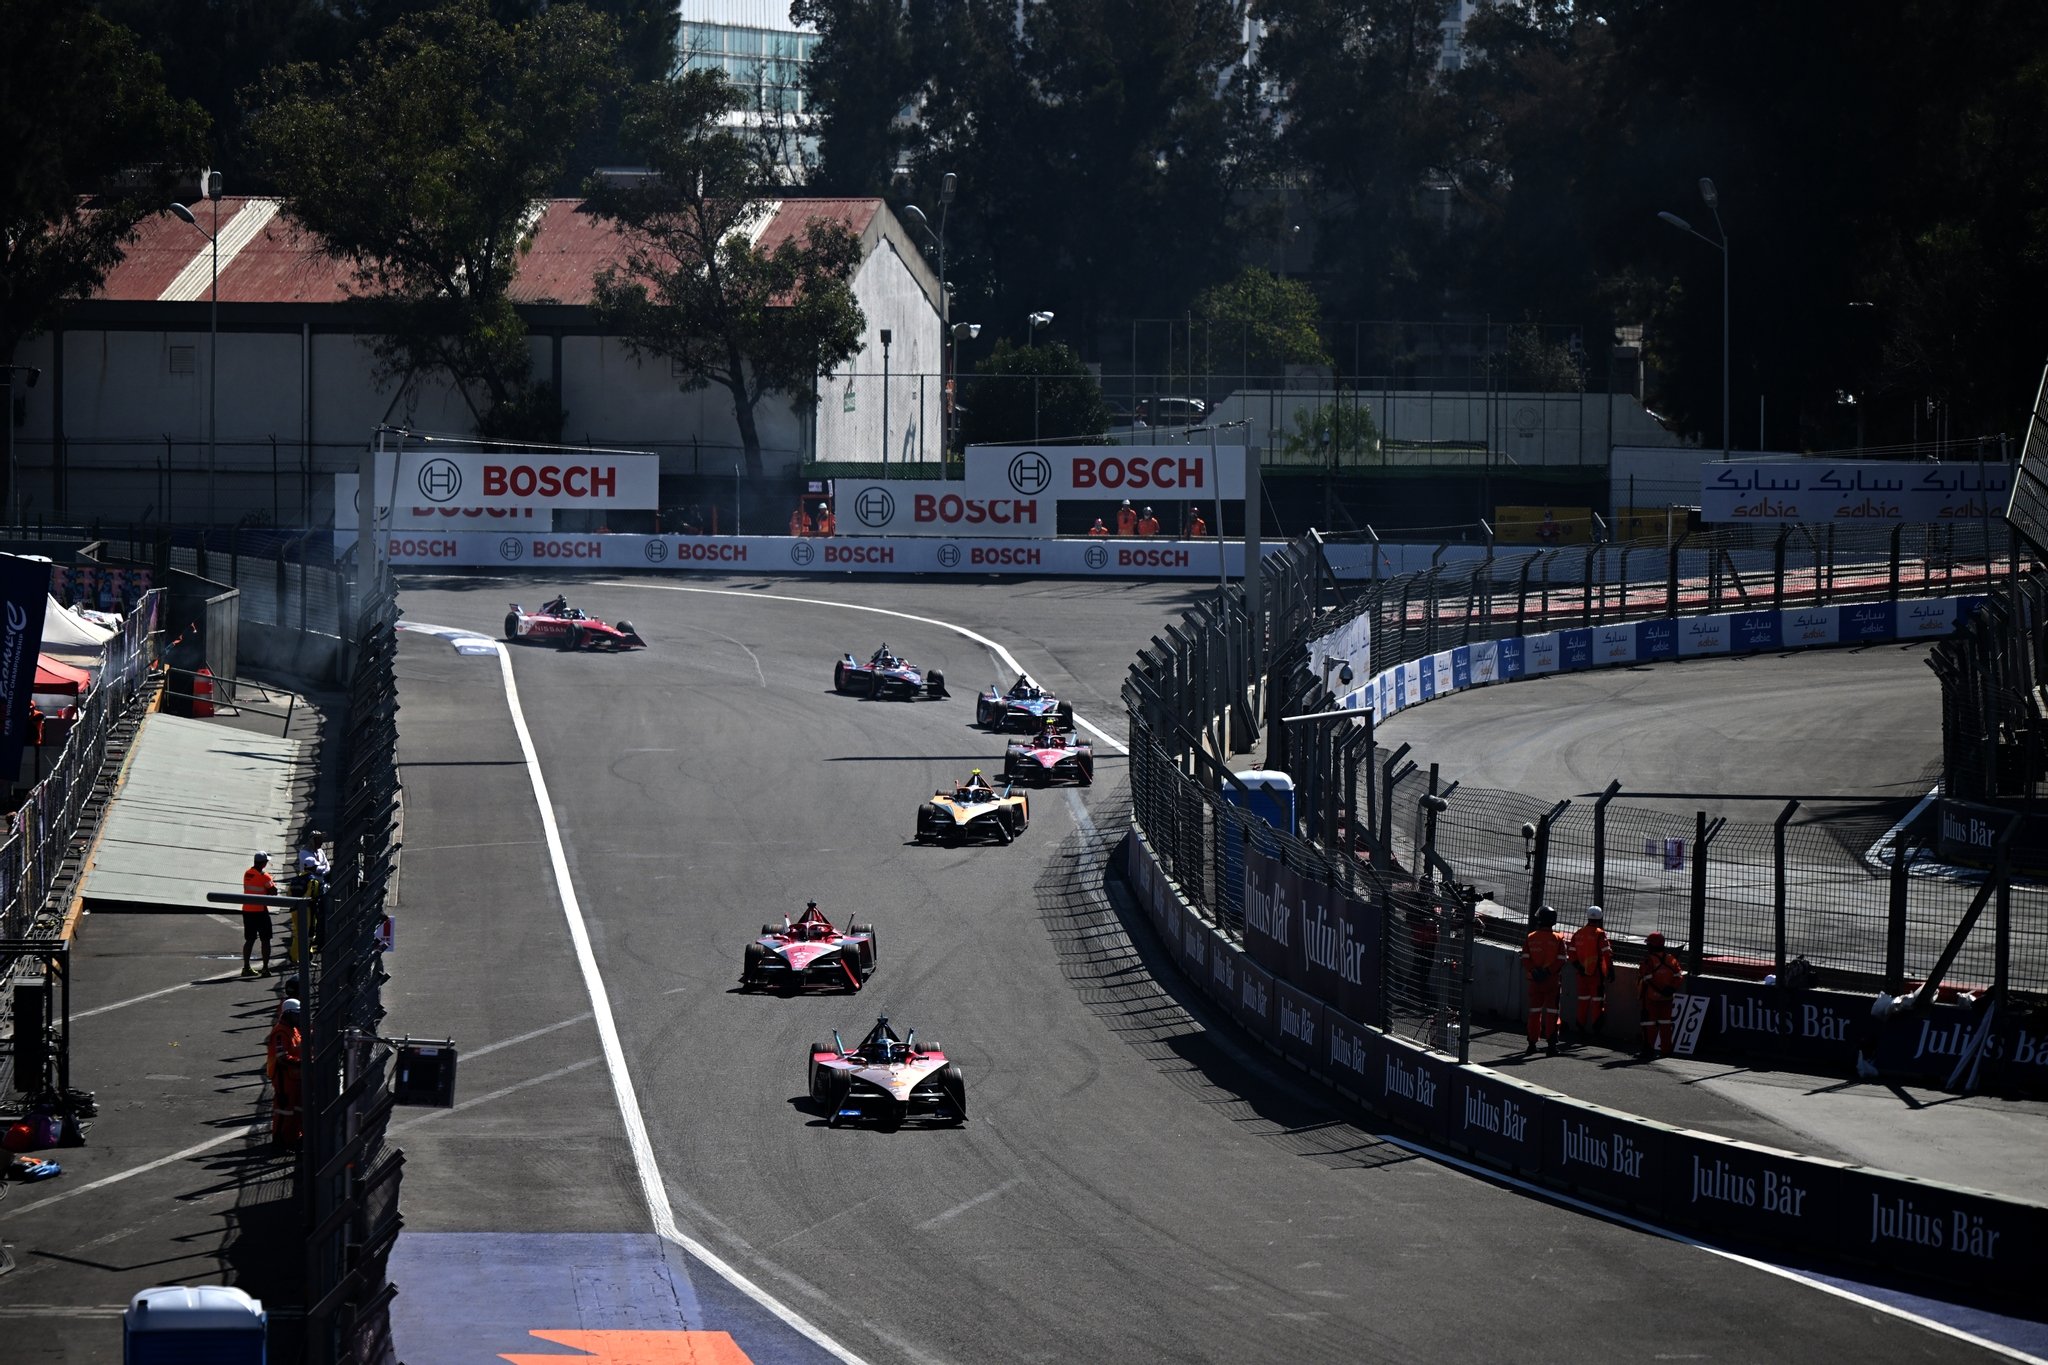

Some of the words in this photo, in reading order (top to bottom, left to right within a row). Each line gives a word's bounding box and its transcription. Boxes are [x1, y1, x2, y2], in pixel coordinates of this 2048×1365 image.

[483, 465, 616, 497] BOSCH
[1072, 457, 1203, 488] BOSCH
[1706, 470, 1800, 498] سابك
[1808, 470, 1902, 498] سابك
[914, 494, 1037, 524] BOSCH
[1731, 497, 1799, 517] sabic
[1834, 498, 1902, 517] sabic
[389, 540, 457, 557] BOSCH
[533, 541, 601, 558] BOSCH
[678, 543, 747, 561] BOSCH
[824, 546, 894, 563] BOSCH
[971, 548, 1040, 565] BOSCH
[1118, 550, 1188, 567] BOSCH
[534, 624, 567, 633] NISSAN
[1969, 818, 1996, 848] Bär
[1245, 865, 1270, 935] Julius
[1272, 882, 1290, 947] Bär
[1339, 916, 1366, 986] Bär
[1719, 994, 1794, 1036] Julius
[1800, 1003, 1851, 1042] Bär
[1329, 1023, 1351, 1067] Julius
[1352, 1035, 1367, 1076] Bär
[1913, 1019, 2004, 1060] Julis
[1384, 1053, 1414, 1099] Julius
[1416, 1066, 1437, 1108] Bär
[1464, 1085, 1499, 1133] Julius
[1503, 1099, 1527, 1143] Bär
[1562, 1119, 1608, 1169] Julius
[1612, 1133, 1644, 1179] Bär
[1691, 1155, 1756, 1207] Julius
[1762, 1169, 1807, 1217] Bär
[1871, 1193, 1943, 1248] Julius
[1950, 1210, 2000, 1260] Bär
